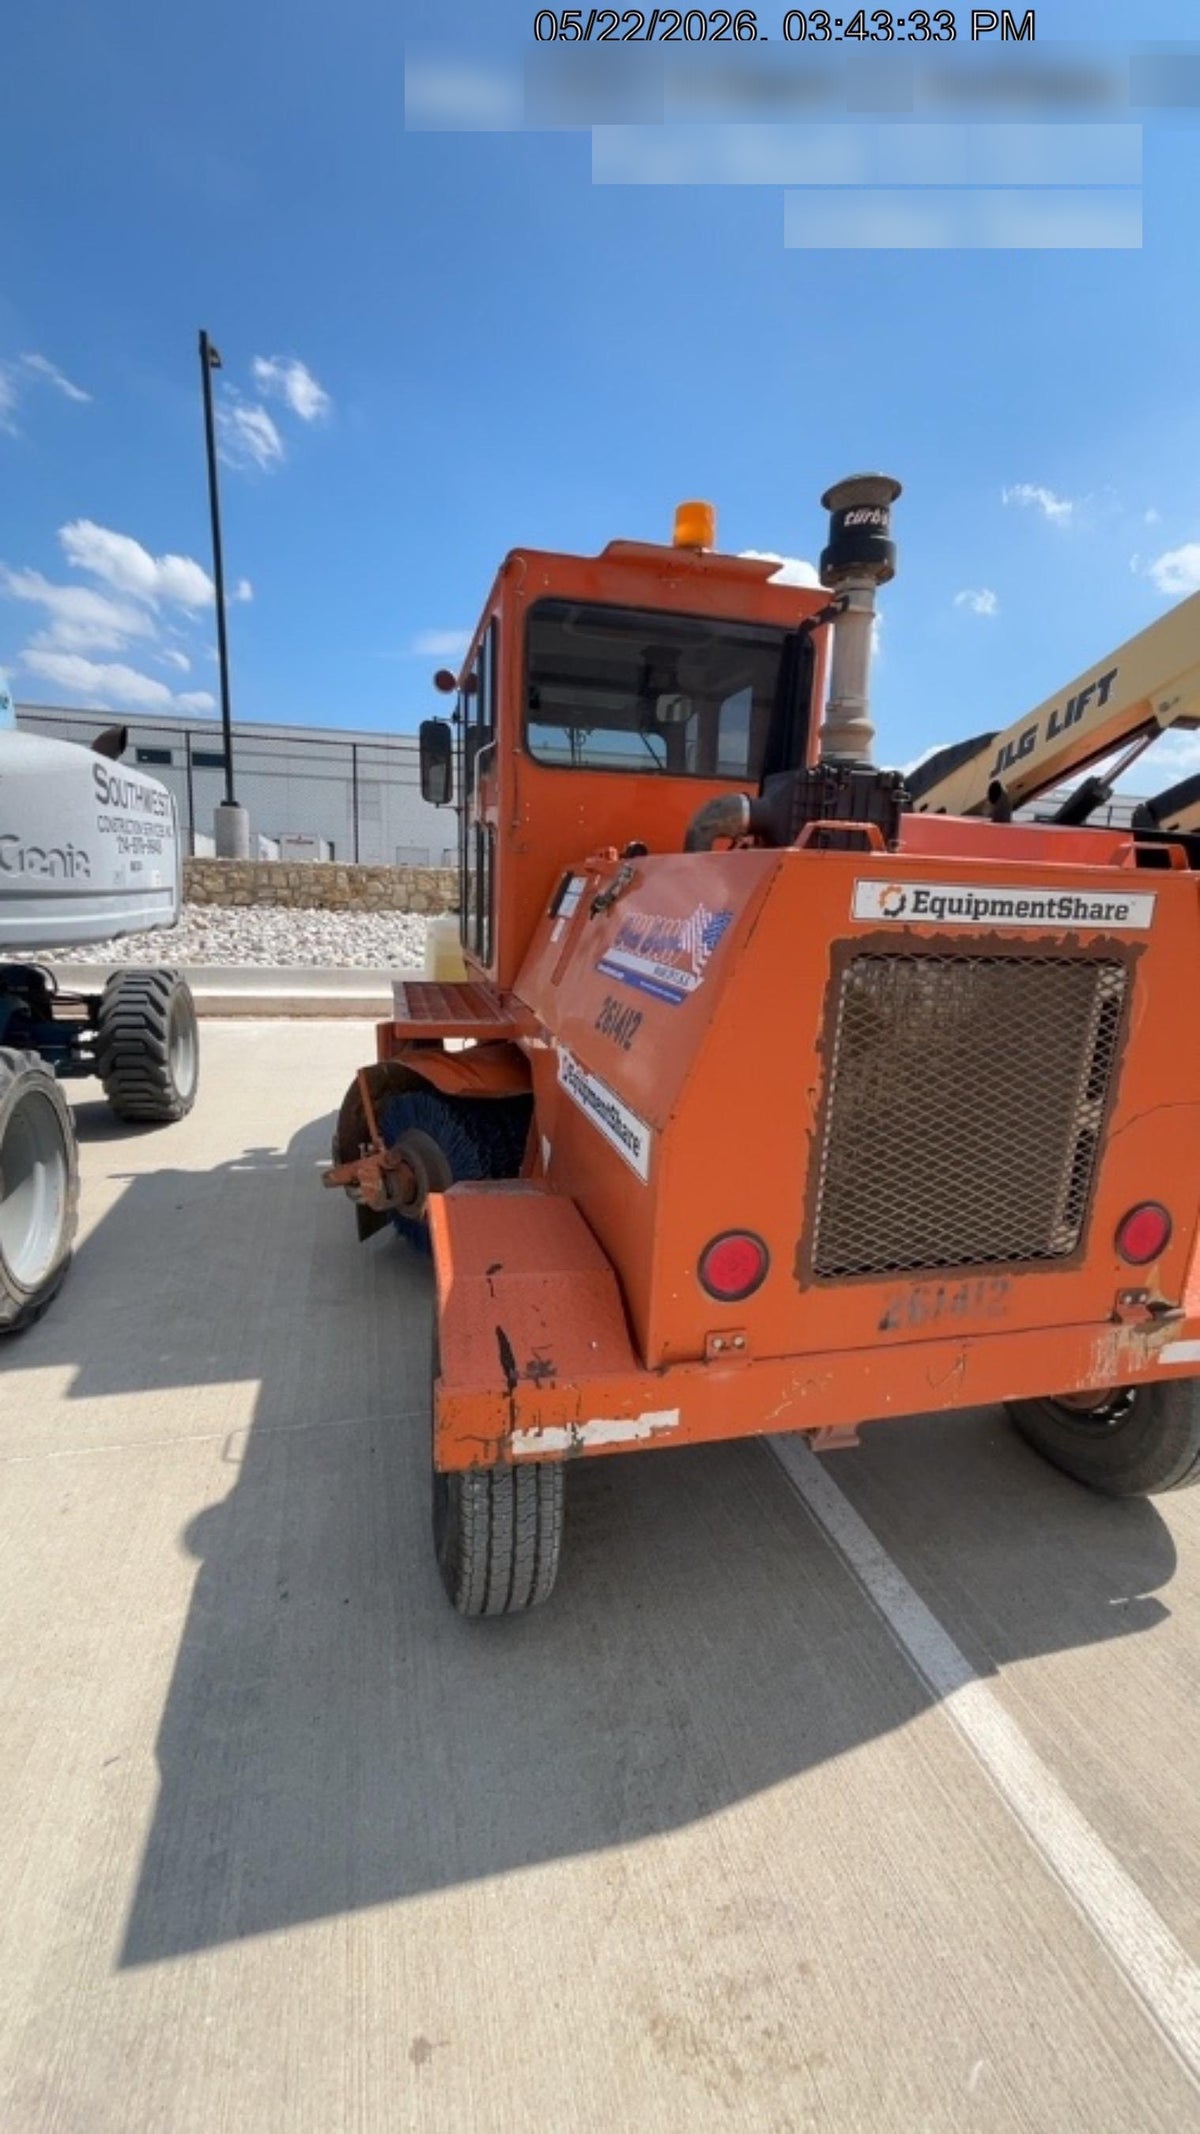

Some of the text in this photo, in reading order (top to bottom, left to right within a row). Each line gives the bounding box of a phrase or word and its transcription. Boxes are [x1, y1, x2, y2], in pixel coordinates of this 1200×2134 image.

[989, 666, 1119, 779] JLG LIFT
[0, 833, 91, 878] Genie
[911, 889, 1130, 921] EquipmentShare
[593, 995, 644, 1052] 261412
[567, 1065, 643, 1159] EquipmentShare
